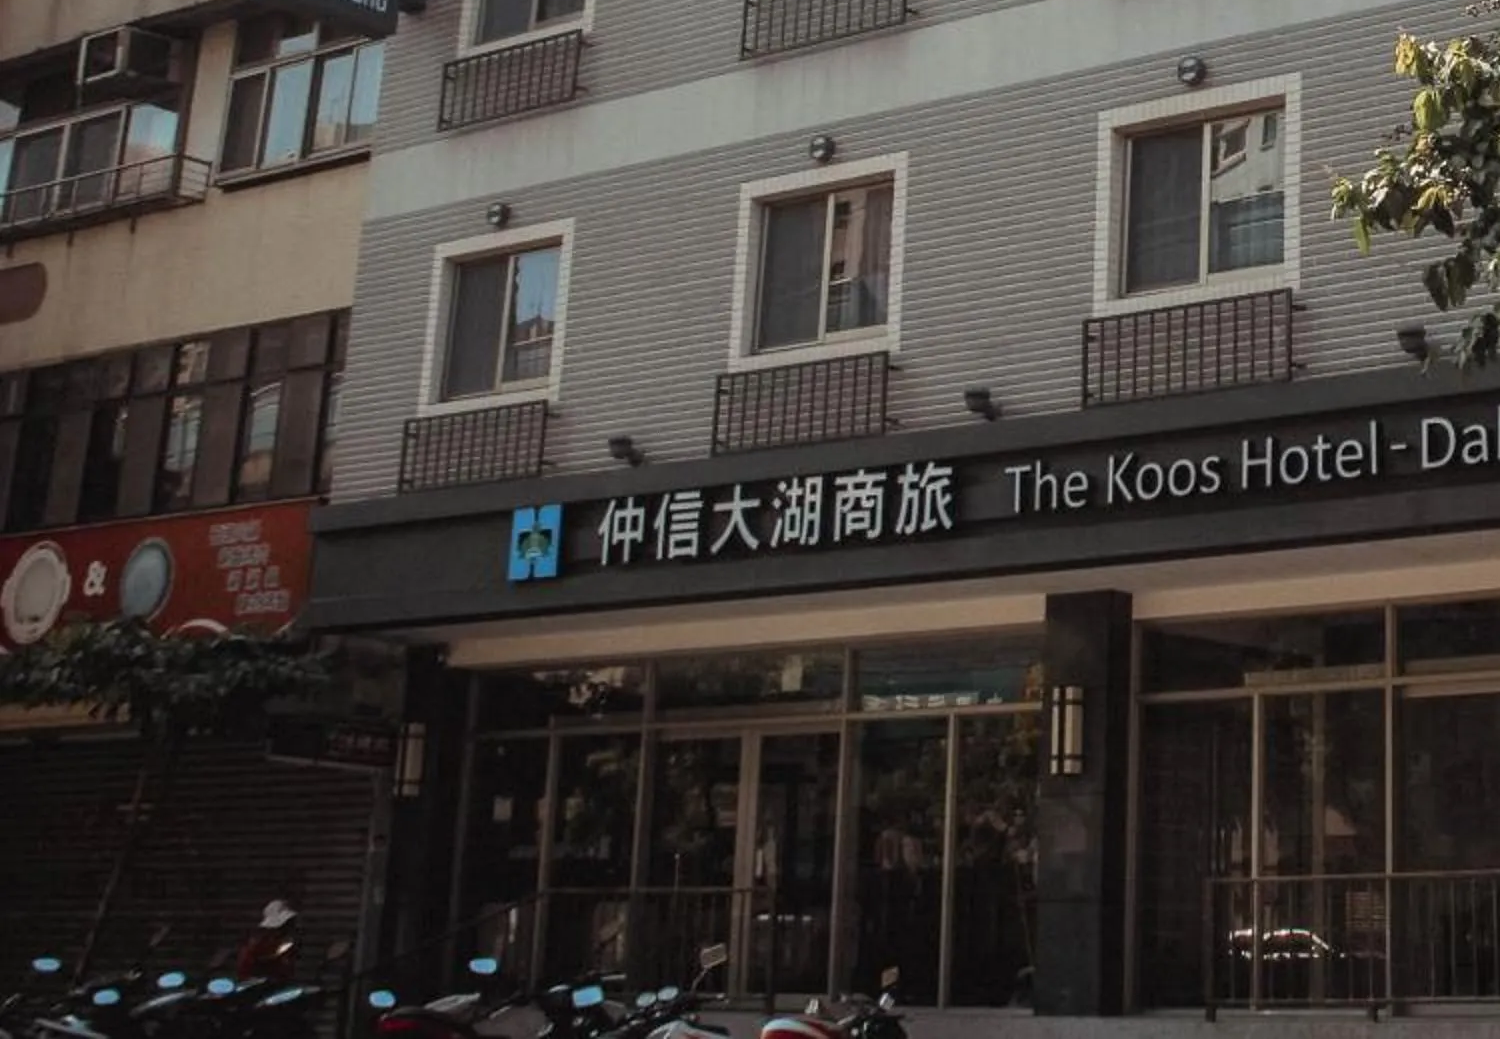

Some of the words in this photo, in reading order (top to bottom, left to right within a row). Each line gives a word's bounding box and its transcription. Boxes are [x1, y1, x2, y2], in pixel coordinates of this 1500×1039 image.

[598, 461, 954, 565] 仲信大湖商旅
[1005, 461, 1089, 515] The
[1107, 452, 1220, 506] Koos
